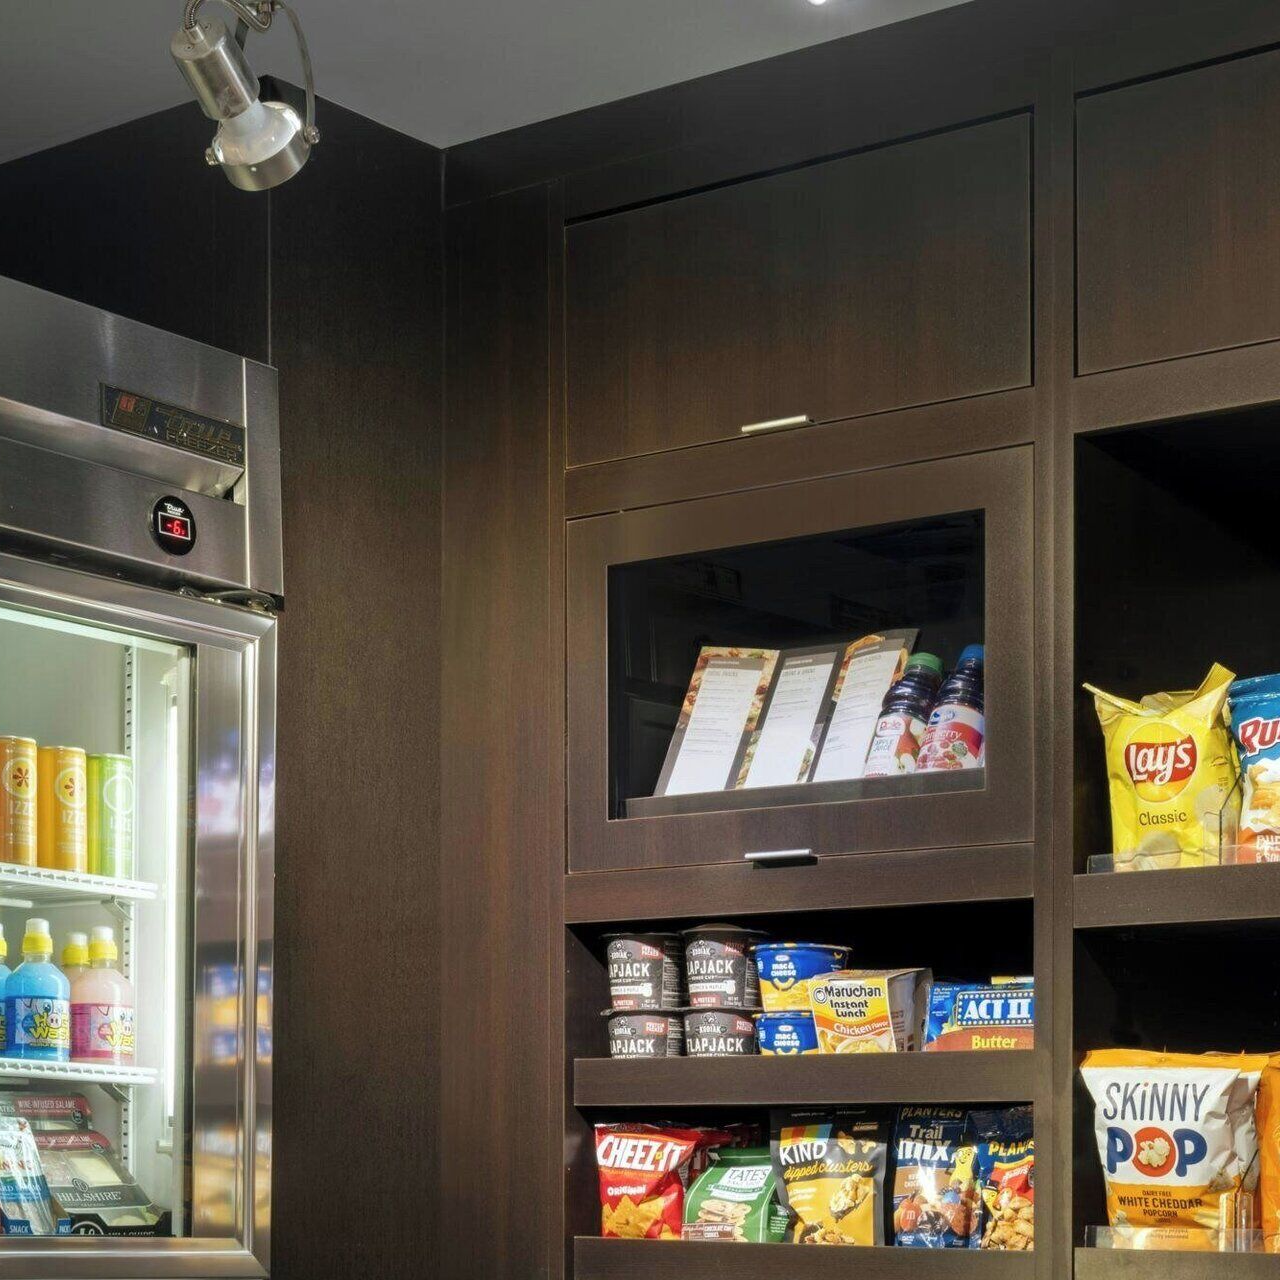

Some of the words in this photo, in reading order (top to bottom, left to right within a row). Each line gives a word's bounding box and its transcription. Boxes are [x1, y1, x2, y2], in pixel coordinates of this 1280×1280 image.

[1129, 737, 1192, 786] Lay's
[1139, 809, 1187, 827] Classic
[770, 969, 797, 977] cheese
[824, 985, 882, 999] Maruchan
[830, 1000, 869, 1010] Instant
[836, 1008, 866, 1019] Lunch
[972, 1034, 1017, 1050] Butter
[901, 1106, 963, 1119] PLANTERS
[909, 1124, 943, 1140] Trail
[779, 1142, 827, 1166] KIND
[1106, 1126, 1207, 1178] POP
[729, 1167, 768, 1183] TATE'S
[56, 1191, 121, 1202] HILLSHIRE
[1118, 1196, 1150, 1208] WHITE
[1151, 1196, 1203, 1210] CHEDDAR
[1143, 1208, 1178, 1218] POPCORN
[9, 1224, 28, 1234] SNACK
